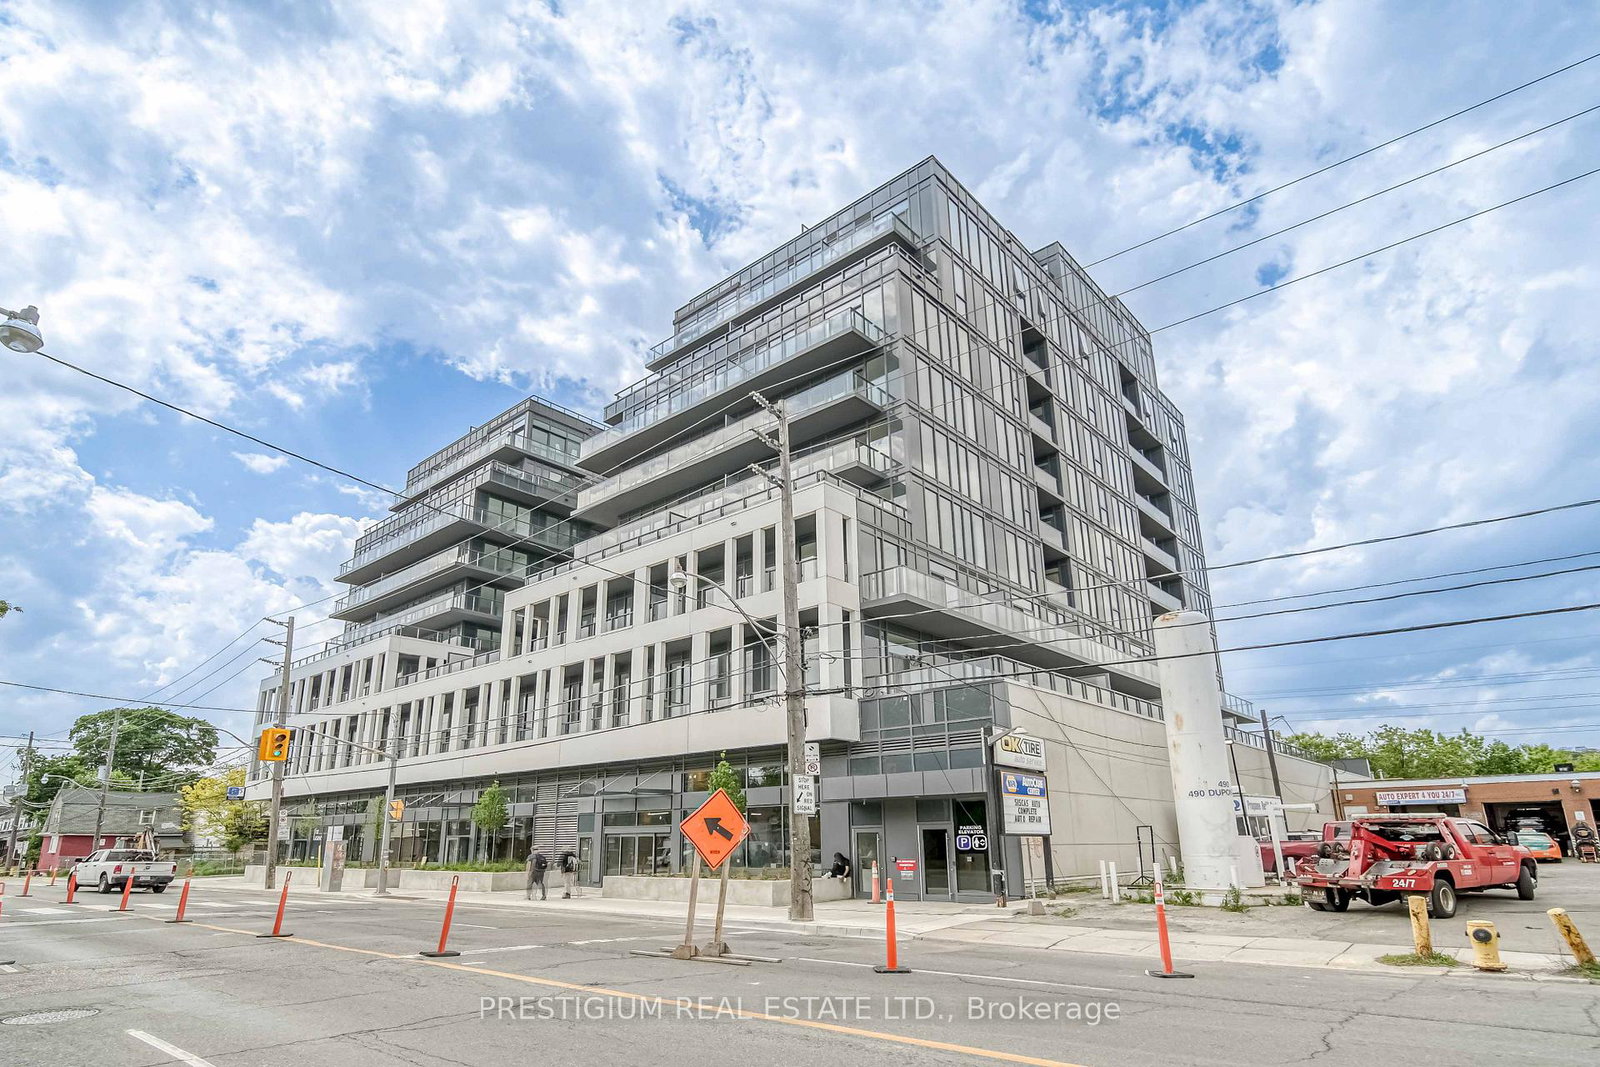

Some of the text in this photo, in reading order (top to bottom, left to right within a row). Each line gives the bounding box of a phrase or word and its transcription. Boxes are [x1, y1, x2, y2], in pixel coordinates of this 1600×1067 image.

[1001, 734, 1041, 755] OK TIRE
[1396, 792, 1420, 800] EXPERT
[1427, 791, 1440, 799] YOU
[1017, 807, 1037, 815] COMPLETE
[1392, 879, 1415, 888] 24/7
